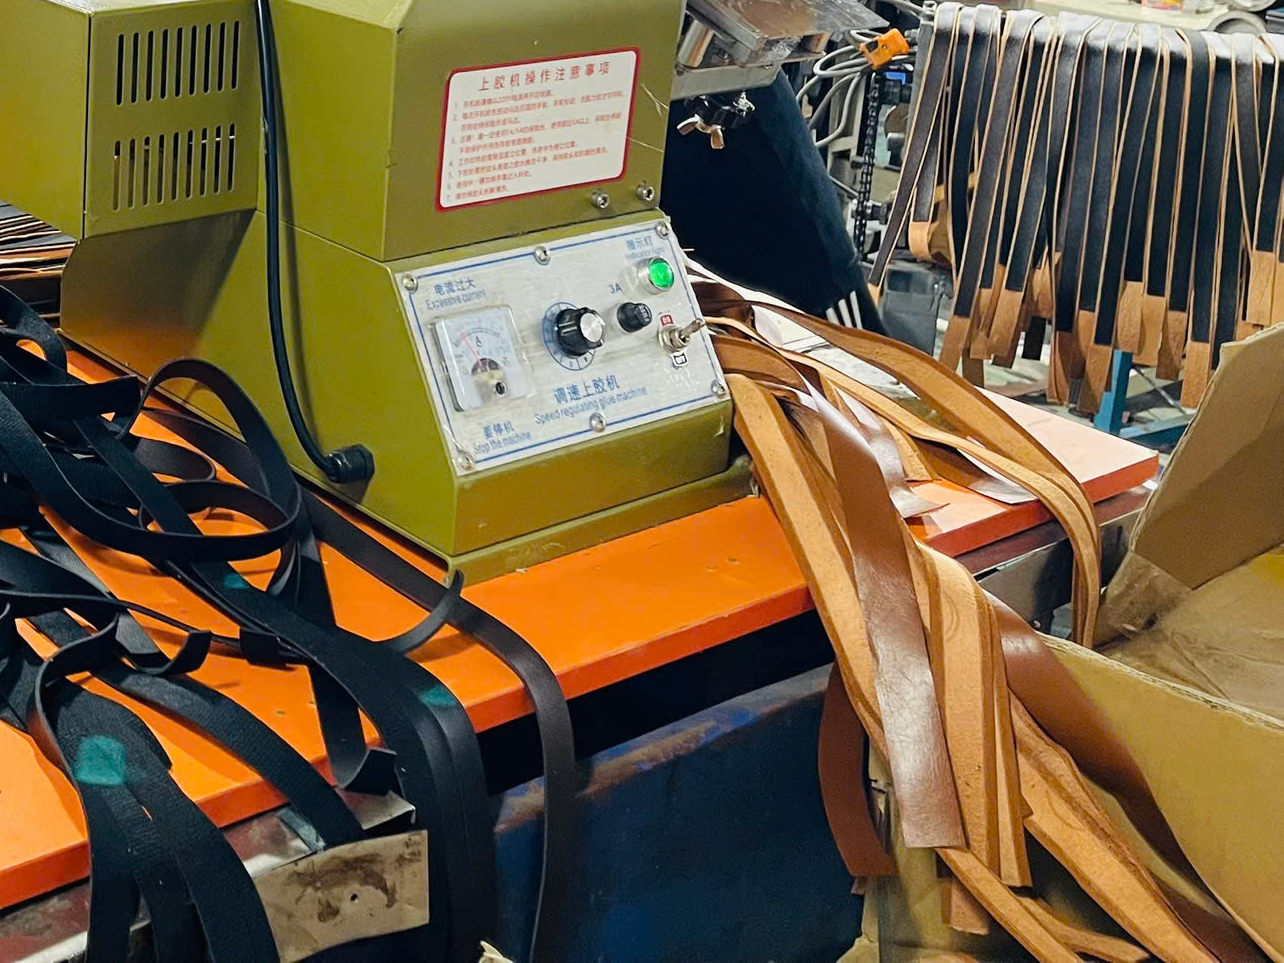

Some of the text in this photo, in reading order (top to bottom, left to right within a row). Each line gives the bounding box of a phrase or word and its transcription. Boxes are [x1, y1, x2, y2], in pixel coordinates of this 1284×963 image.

[478, 61, 612, 92] 上胶机操作注意事项
[435, 277, 476, 295] 电流过大
[609, 283, 623, 294] 3A
[426, 295, 462, 310] Excessive
[553, 374, 620, 404] 调速上胶机
[534, 387, 648, 425] Speed regulating glue machine
